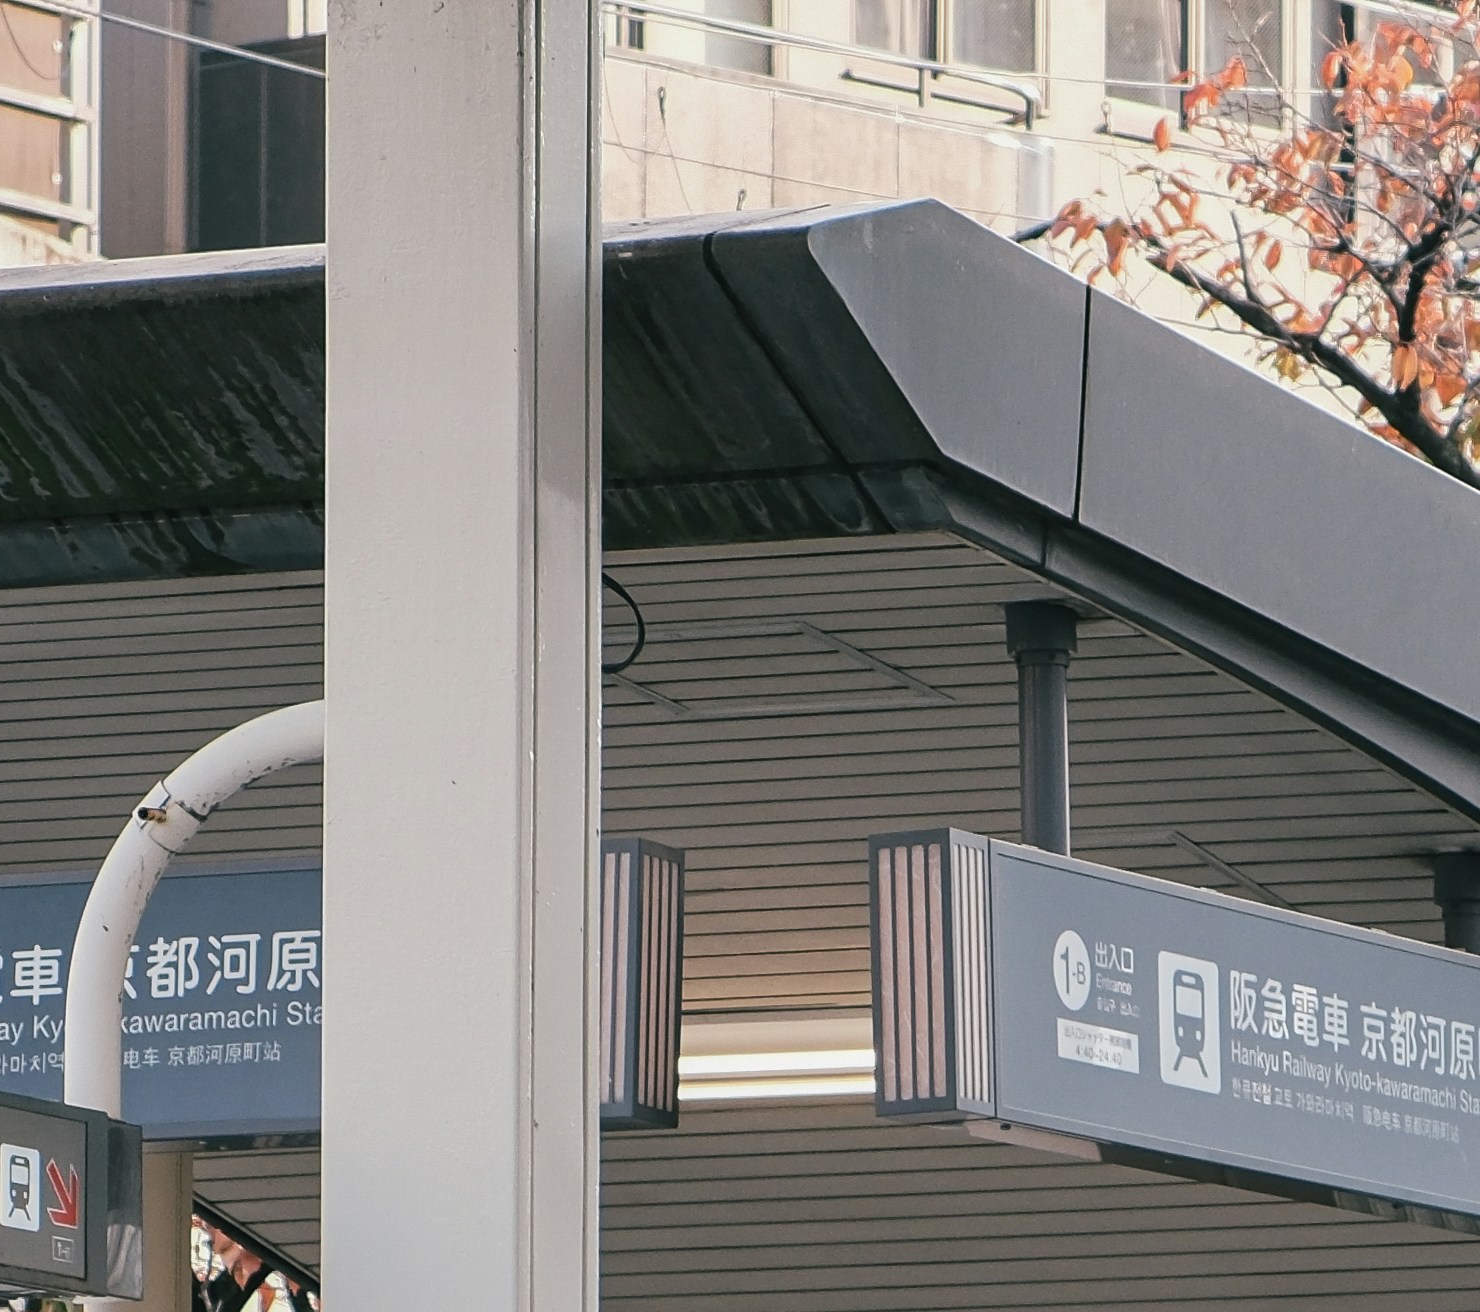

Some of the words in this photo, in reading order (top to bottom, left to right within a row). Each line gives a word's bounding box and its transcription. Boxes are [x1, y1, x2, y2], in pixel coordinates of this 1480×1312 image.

[1060, 946, 1085, 994] 1-B
[1095, 941, 1134, 973] 出入口
[1096, 972, 1133, 996] Entrance
[1230, 969, 1350, 1052] 阪急電車
[123, 1048, 160, 1069] 电车
[1231, 1040, 1279, 1077] Hankyu
[1283, 1050, 1331, 1088] Railway
[1335, 1061, 1457, 1111] Kyoto-kawaramachi
